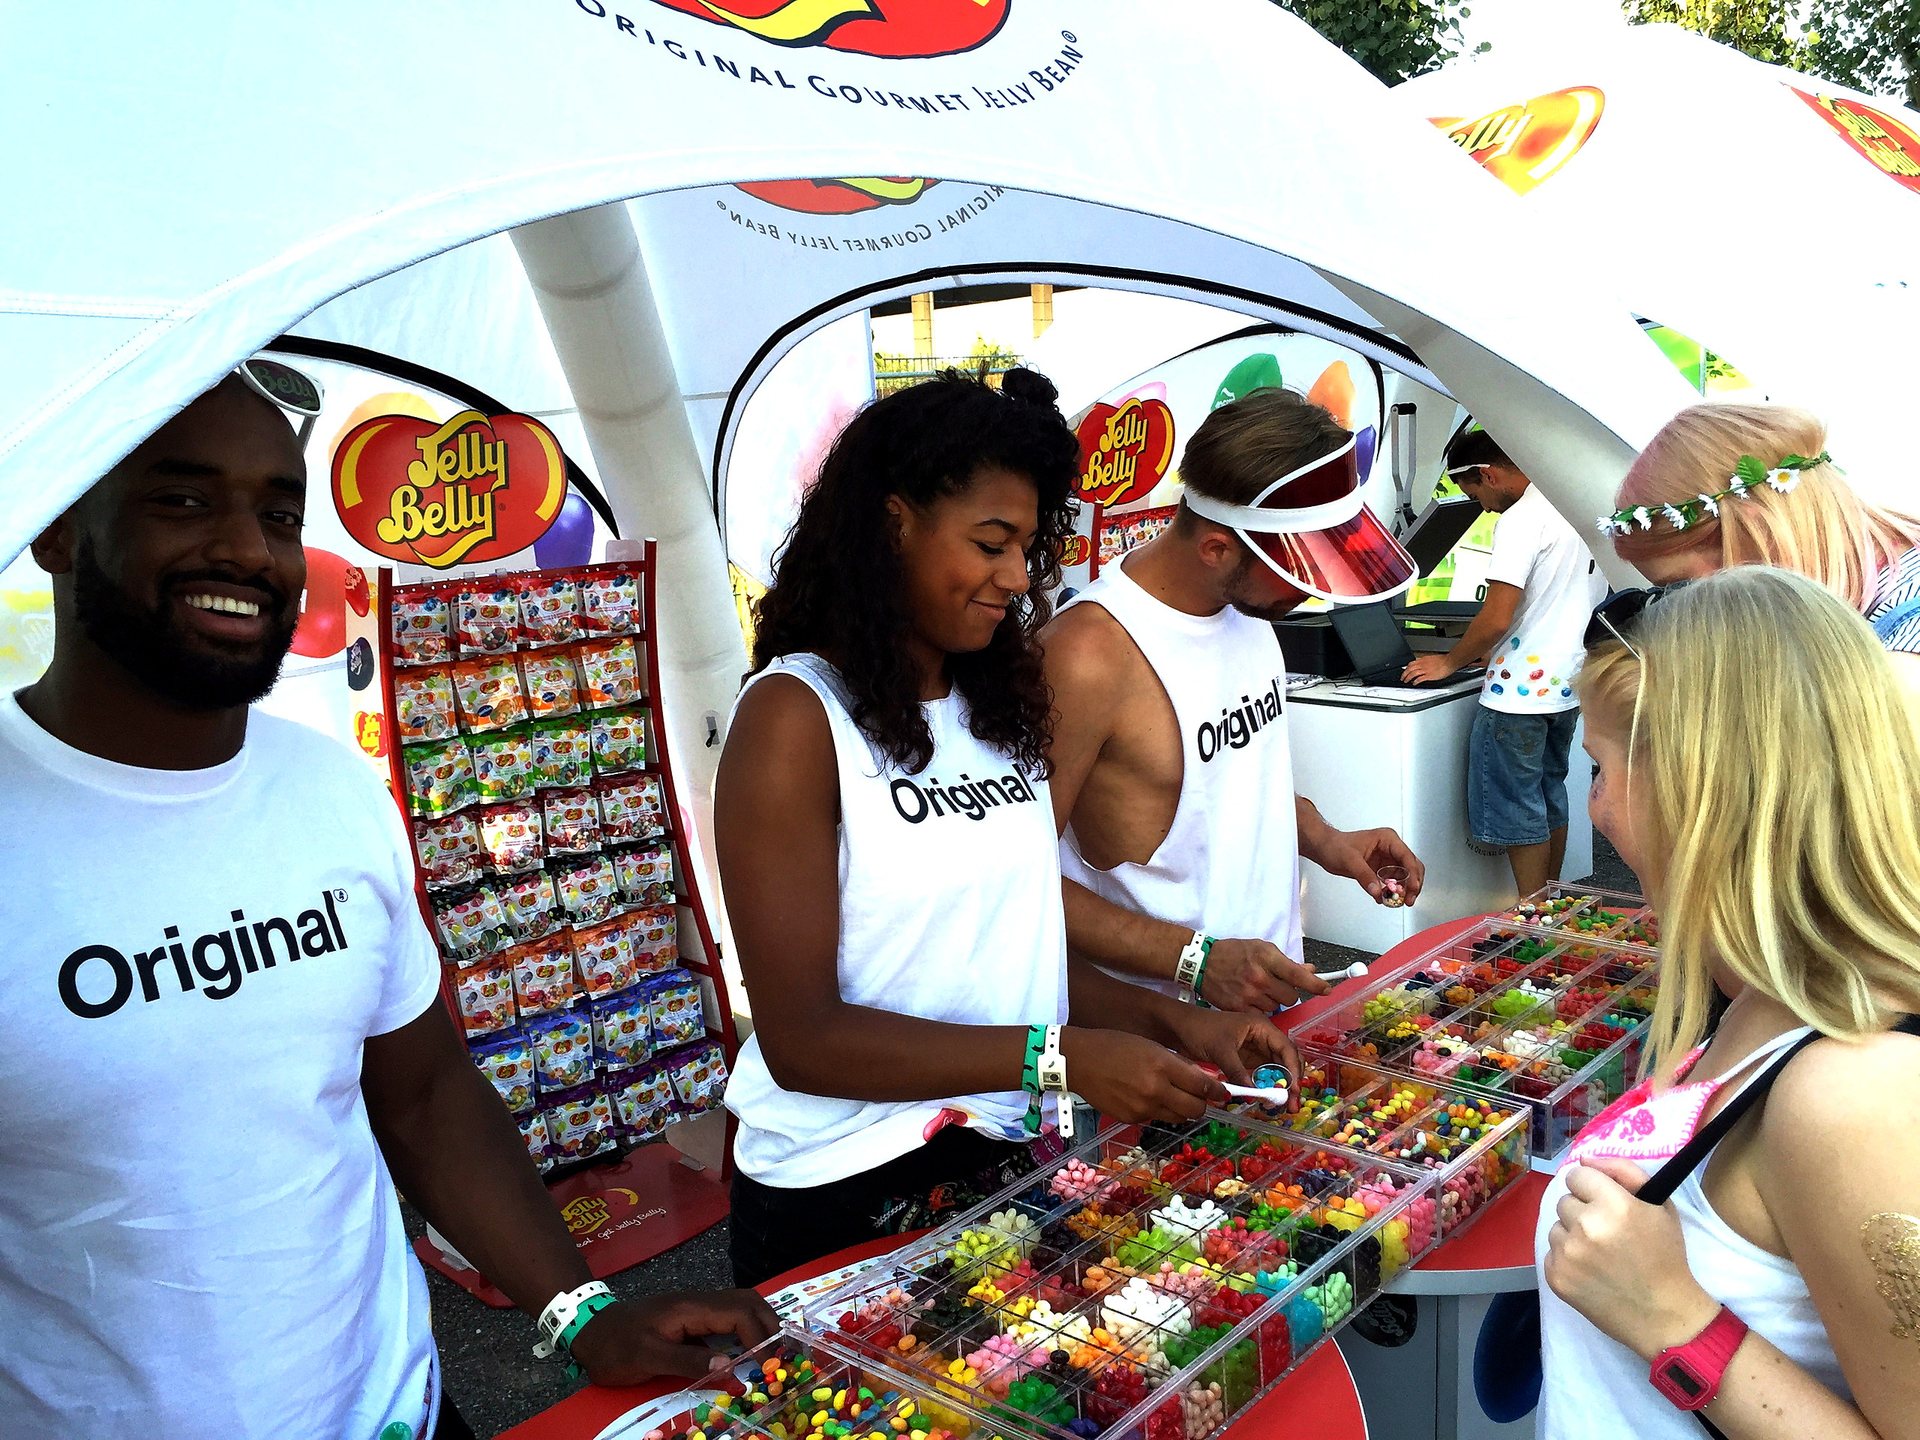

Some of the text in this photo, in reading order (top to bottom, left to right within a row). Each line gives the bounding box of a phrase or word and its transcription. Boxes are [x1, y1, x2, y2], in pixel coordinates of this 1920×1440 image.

[807, 74, 970, 114] GOURMET
[972, 81, 1036, 109] JELLY
[407, 410, 506, 489] Jelly
[1099, 398, 1148, 454] Jelly
[1081, 450, 1137, 507] Belly
[376, 484, 495, 568] Belly
